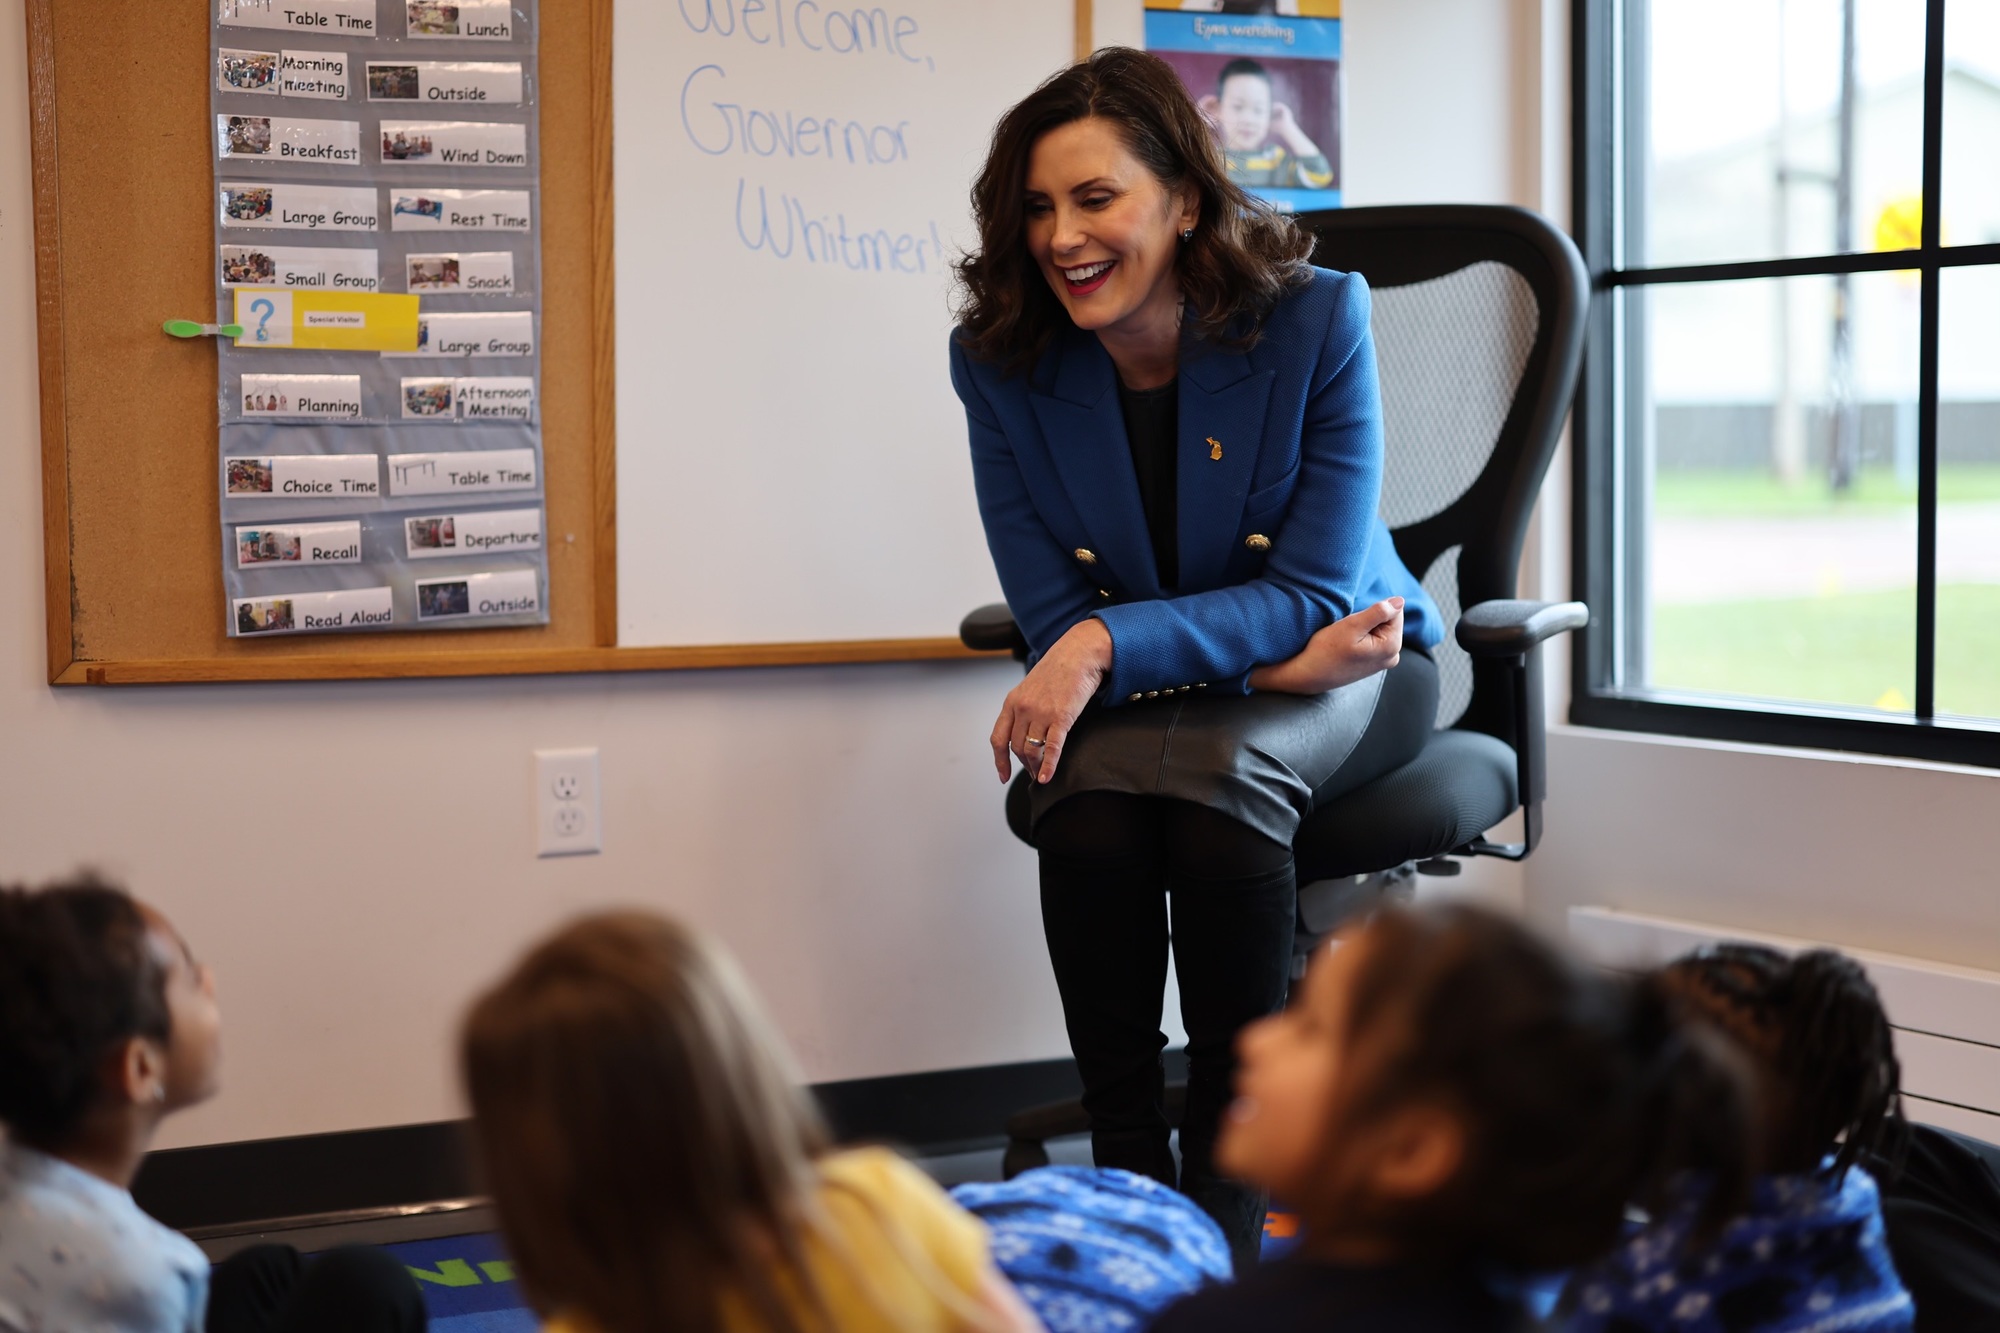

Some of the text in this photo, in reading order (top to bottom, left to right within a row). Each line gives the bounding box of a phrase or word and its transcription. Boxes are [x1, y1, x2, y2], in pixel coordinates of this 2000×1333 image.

[284, 11, 373, 30] Table Time
[466, 23, 509, 37] Lunch
[1194, 17, 1295, 45] Eyes watching
[282, 56, 343, 76] Morning
[284, 78, 345, 98] meeting
[427, 87, 486, 101] Outside
[680, 64, 911, 165] Governor
[280, 142, 358, 161] Breakfast
[441, 149, 524, 164] Wind Down
[282, 209, 376, 228] Large Group
[451, 212, 527, 228] Rest Time
[736, 177, 942, 275] Whitmer!
[284, 272, 376, 290] Small Group
[467, 275, 512, 289] Snack
[308, 315, 360, 325] Special Visitor
[438, 339, 531, 357] Large Group
[458, 387, 531, 400] Afternoon
[298, 398, 359, 417] Planning
[469, 402, 528, 418] Meeting
[282, 479, 377, 493] Choice Time
[449, 469, 532, 486] Table Time
[465, 530, 540, 550] Departure
[312, 545, 358, 560] Recall
[479, 598, 535, 613] Outside
[304, 608, 392, 629] Read Aloud
